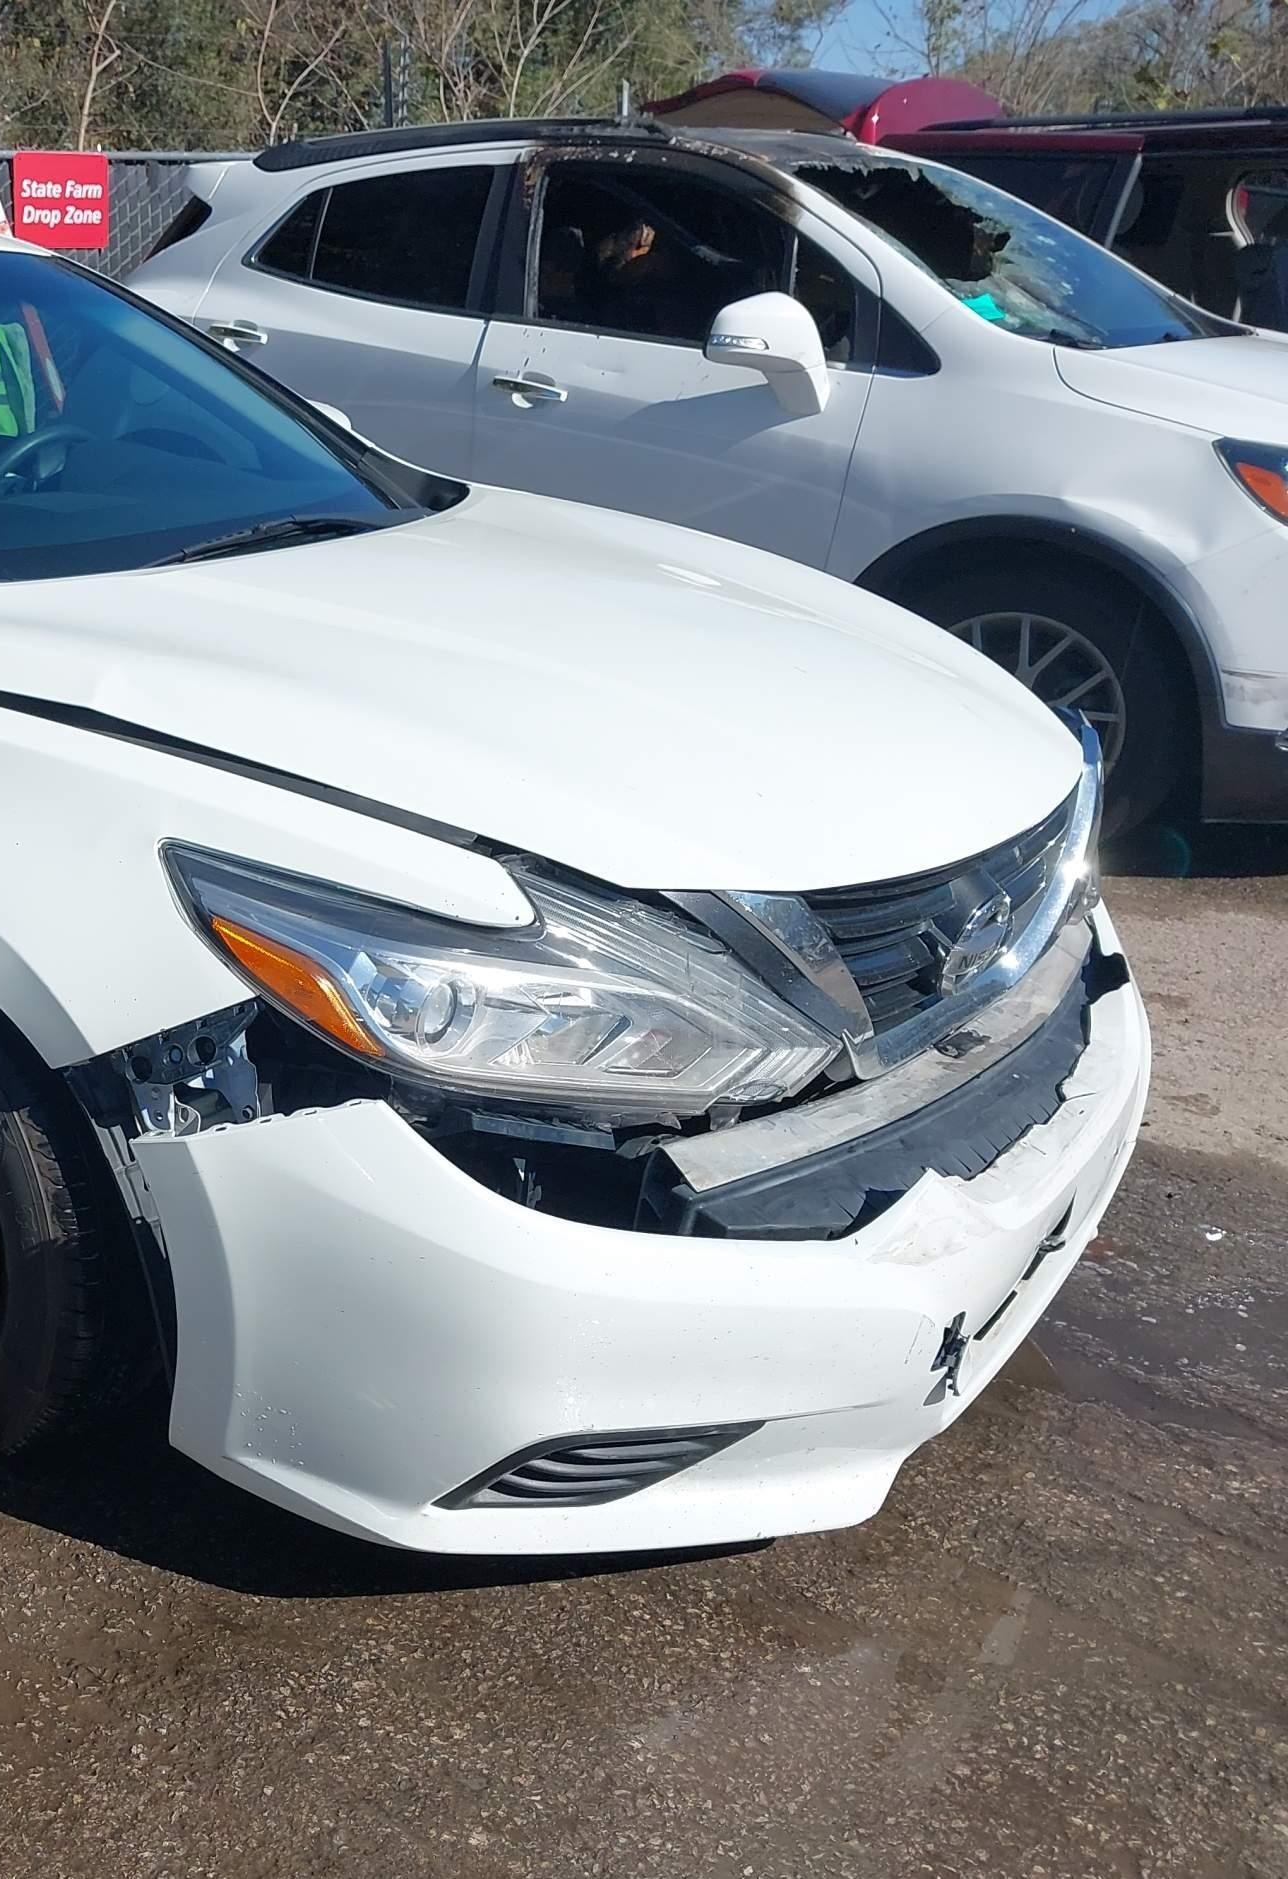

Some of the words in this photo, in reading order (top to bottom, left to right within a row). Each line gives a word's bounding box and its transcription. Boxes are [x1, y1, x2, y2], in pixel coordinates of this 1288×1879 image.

[20, 179, 62, 198] State
[65, 179, 103, 199] Farm
[22, 205, 62, 228] Drop
[64, 205, 102, 224] Zone
